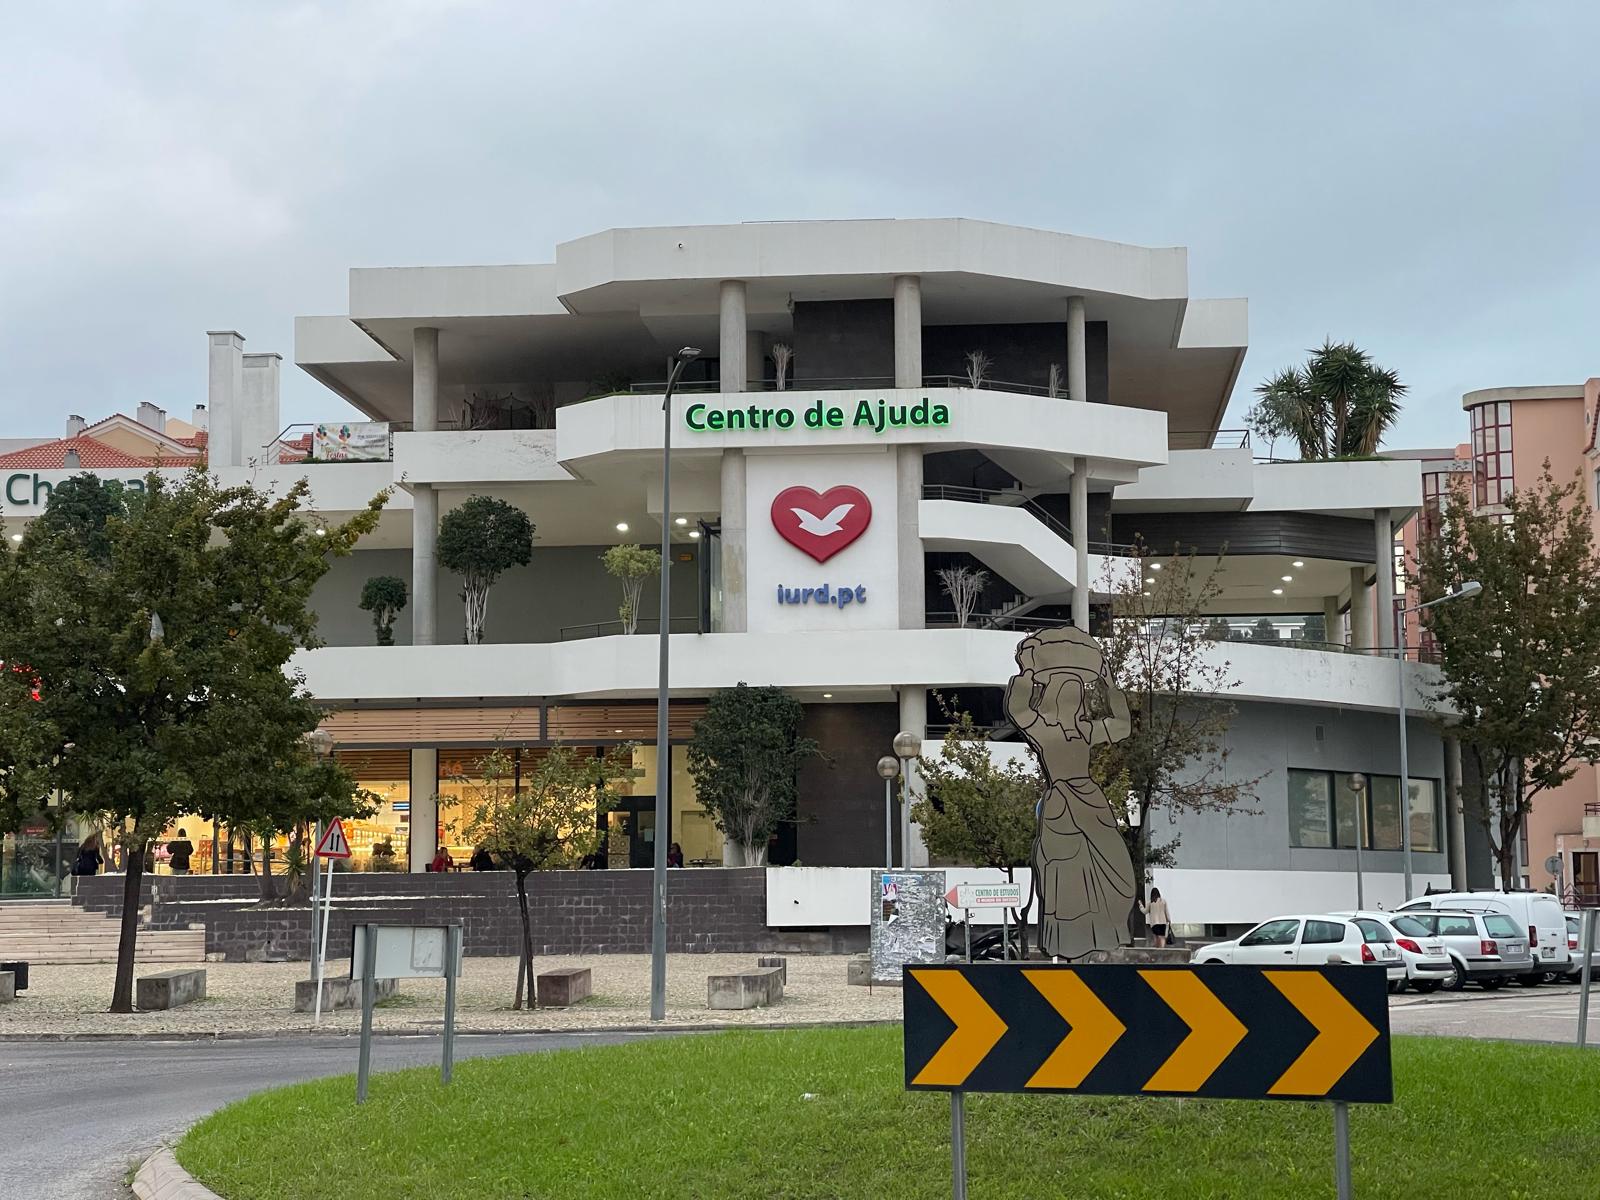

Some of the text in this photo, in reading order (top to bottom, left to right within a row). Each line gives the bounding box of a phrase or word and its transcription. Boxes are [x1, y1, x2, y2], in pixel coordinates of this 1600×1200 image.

[685, 397, 950, 433] Centro de Ajuda
[777, 583, 867, 609] iurd.pt
[975, 888, 1019, 897] CENTRO DE ESTUDOS
